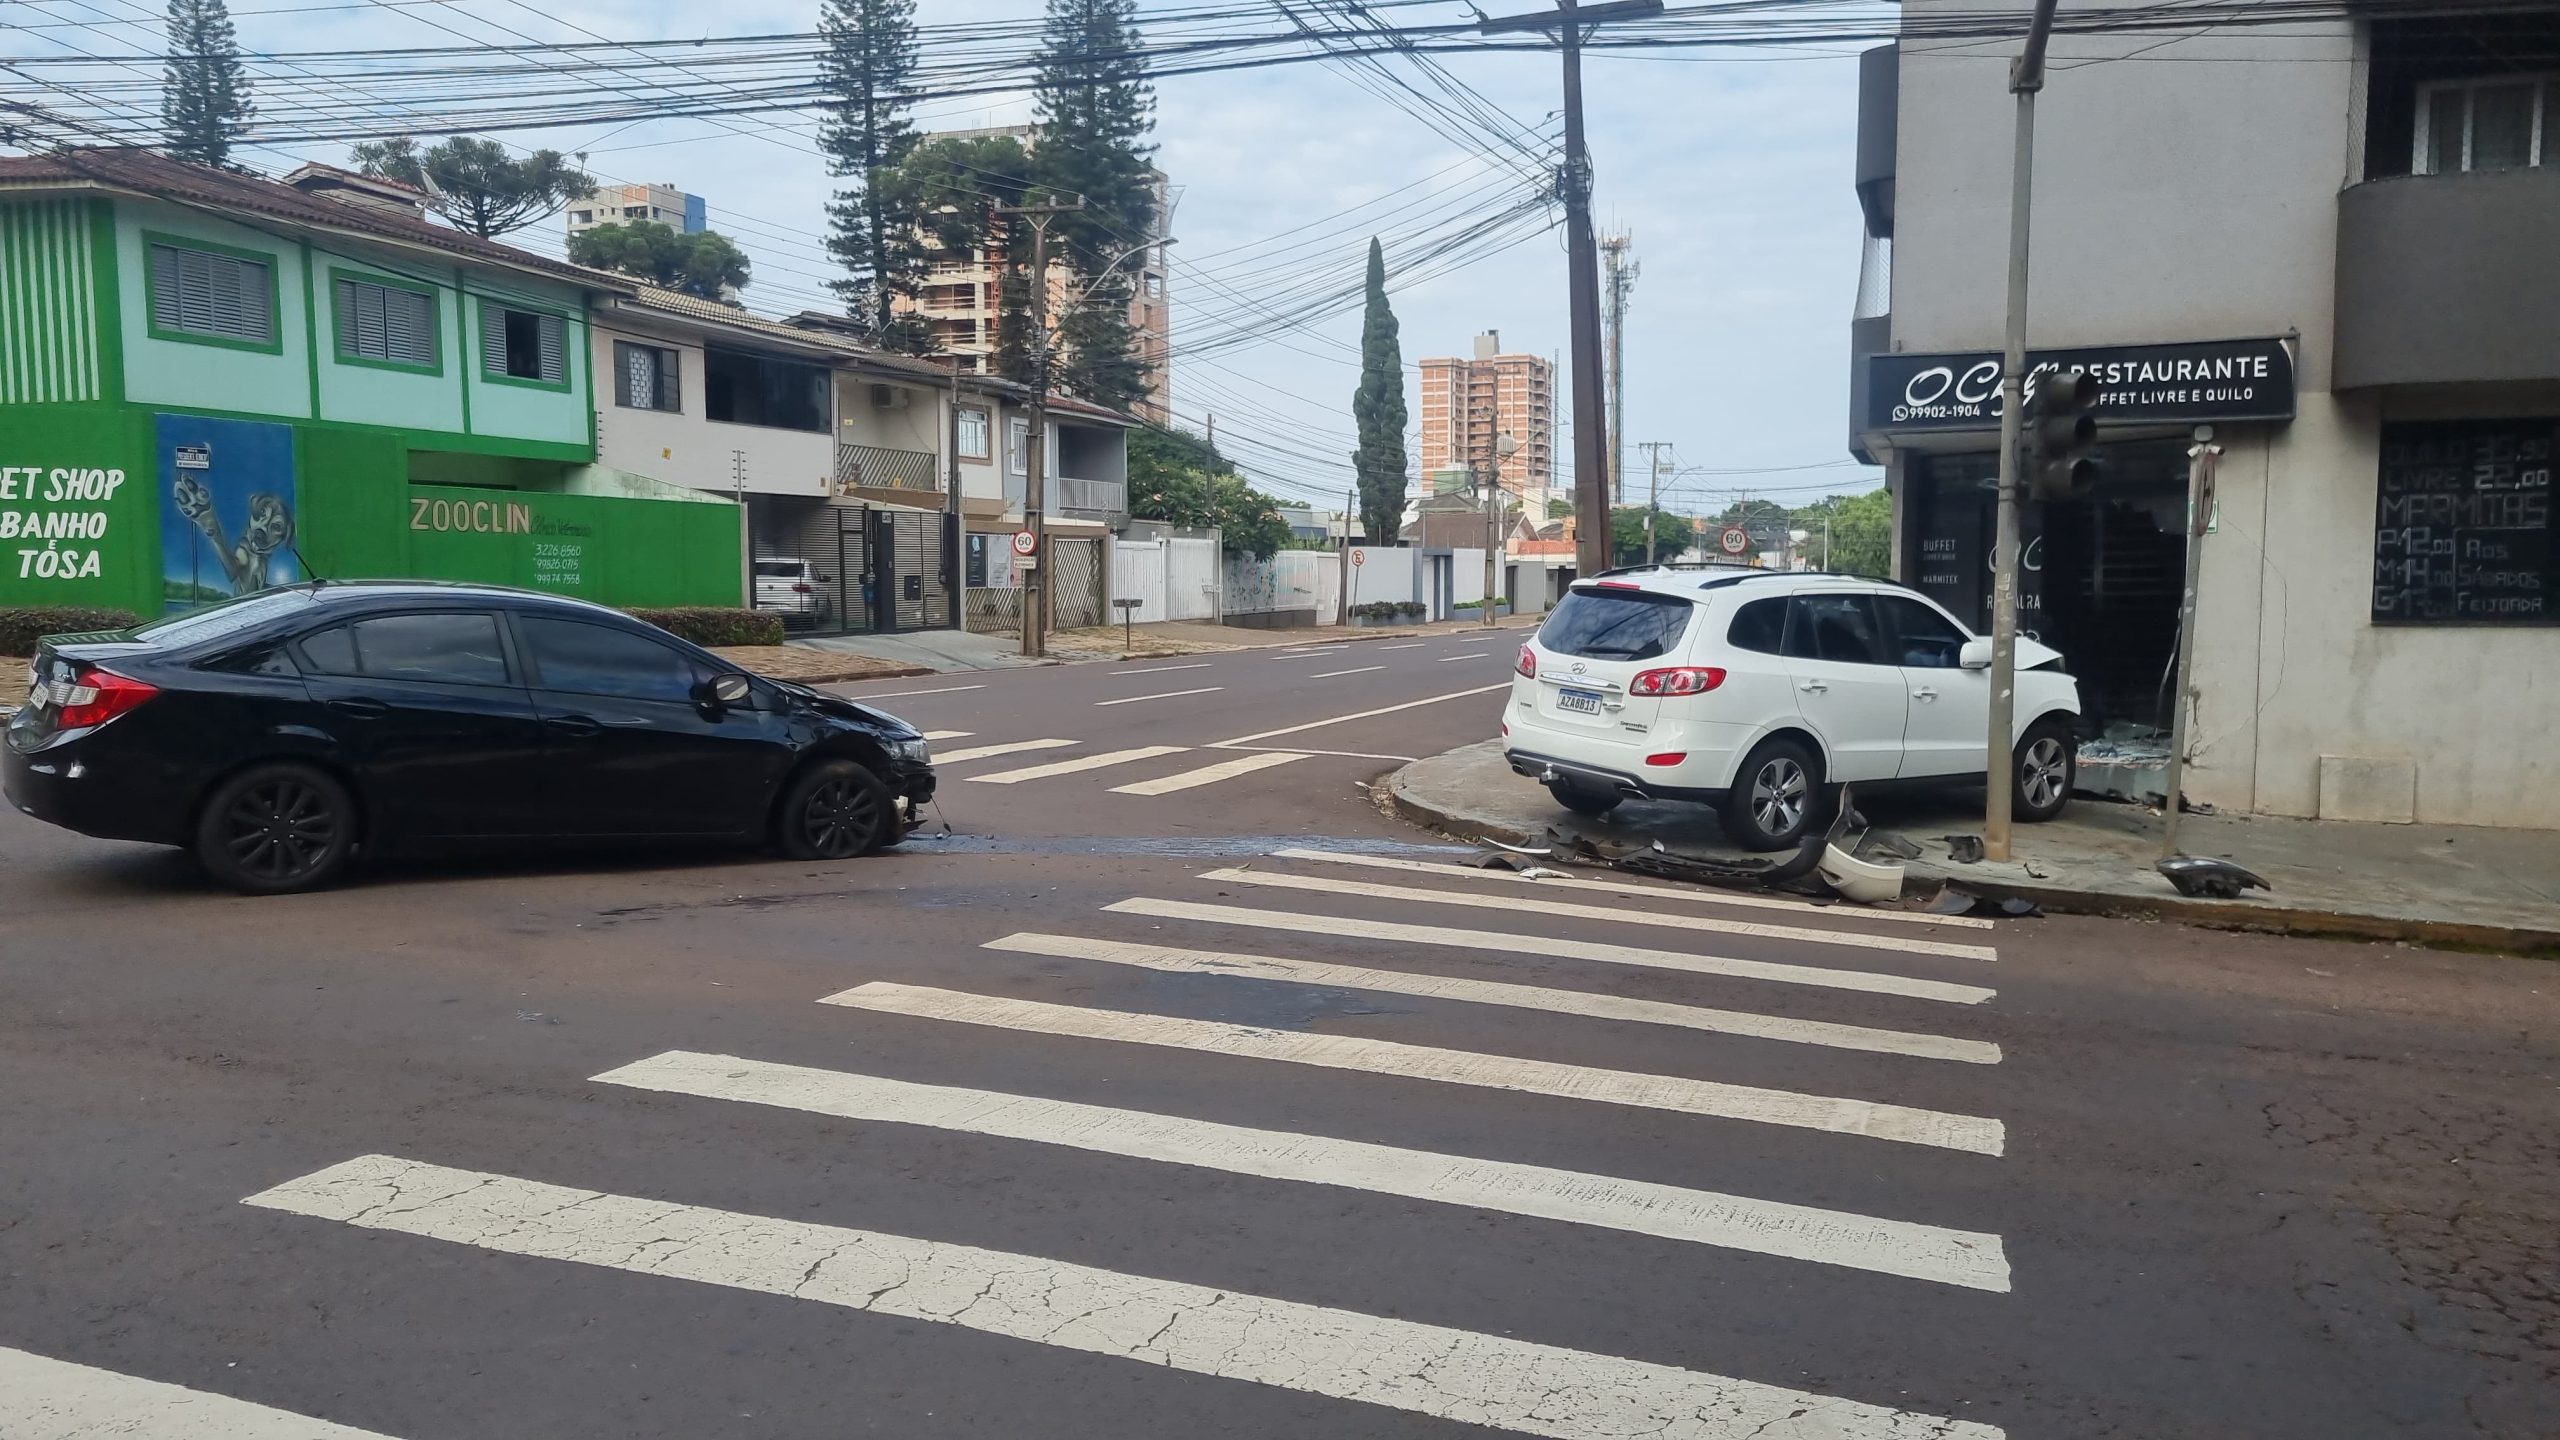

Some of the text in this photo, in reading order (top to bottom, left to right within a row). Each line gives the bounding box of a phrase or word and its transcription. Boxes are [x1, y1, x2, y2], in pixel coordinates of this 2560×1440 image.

[2100, 387, 2253, 406] FFET LIVRE E QUILO
[1909, 405, 1981, 419] 99902-1904
[0, 467, 125, 501] ET SHOP
[409, 498, 531, 535] ZOOCLIN
[0, 511, 108, 539] BANHO
[48, 540, 57, 550] E
[1018, 536, 1031, 546] 60
[1726, 533, 1742, 544] 60
[1923, 539, 1956, 552] BUFFET
[18, 550, 100, 579] TOSA
[1923, 575, 1958, 585] MARMITEX
